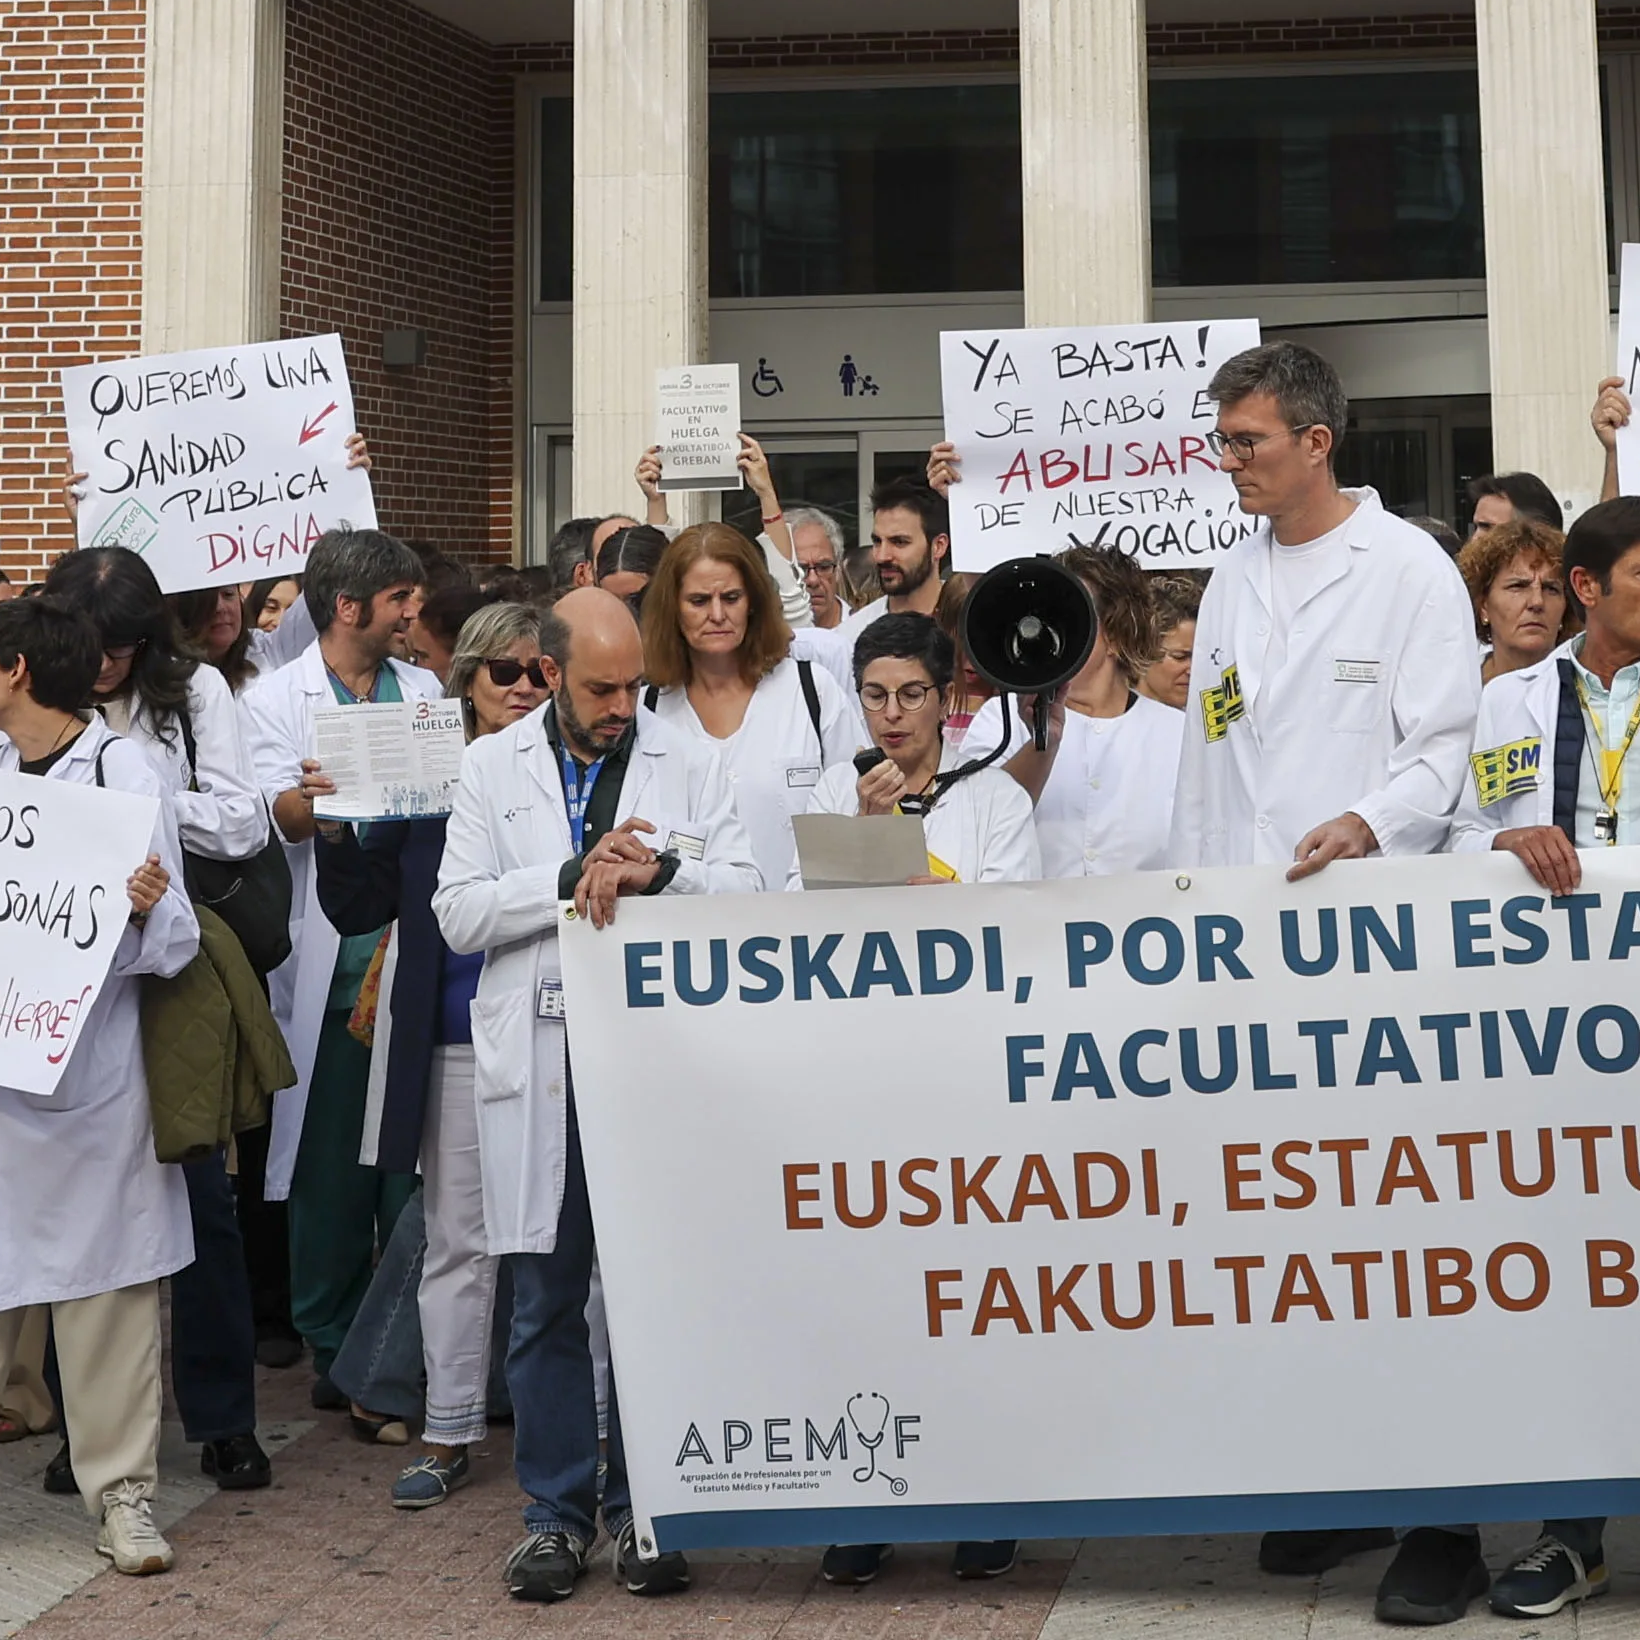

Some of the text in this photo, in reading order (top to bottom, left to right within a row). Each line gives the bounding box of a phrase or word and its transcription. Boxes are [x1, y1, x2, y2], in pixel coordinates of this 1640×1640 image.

[963, 338, 1021, 392] YA
[90, 346, 333, 434] QUEREMOS UNA
[662, 405, 728, 416] FACULTATIV@
[688, 416, 701, 424] EN
[975, 389, 1219, 438] SE ACABÓ E
[671, 427, 720, 439] HUELGA
[673, 455, 721, 466] GREBAN
[996, 436, 1220, 495] ABUSAR
[974, 487, 1196, 531] DE NUESTRA
[412, 718, 462, 731] HUELGA
[415, 701, 430, 719] 3
[1507, 744, 1542, 774] SM
[623, 925, 1034, 1008] EUSKADI,
[1064, 913, 1254, 989] POR
[1279, 903, 1418, 977] UN
[782, 1148, 1189, 1230] EUSKADI,
[924, 1240, 1552, 1338] FAKULTATIBO
[680, 1472, 729, 1484] Agrupación
[731, 1470, 742, 1479] de
[744, 1470, 802, 1479] Profesionales
[803, 1471, 818, 1480] por
[693, 1481, 820, 1493] Estatuto Médico y Facultativo
